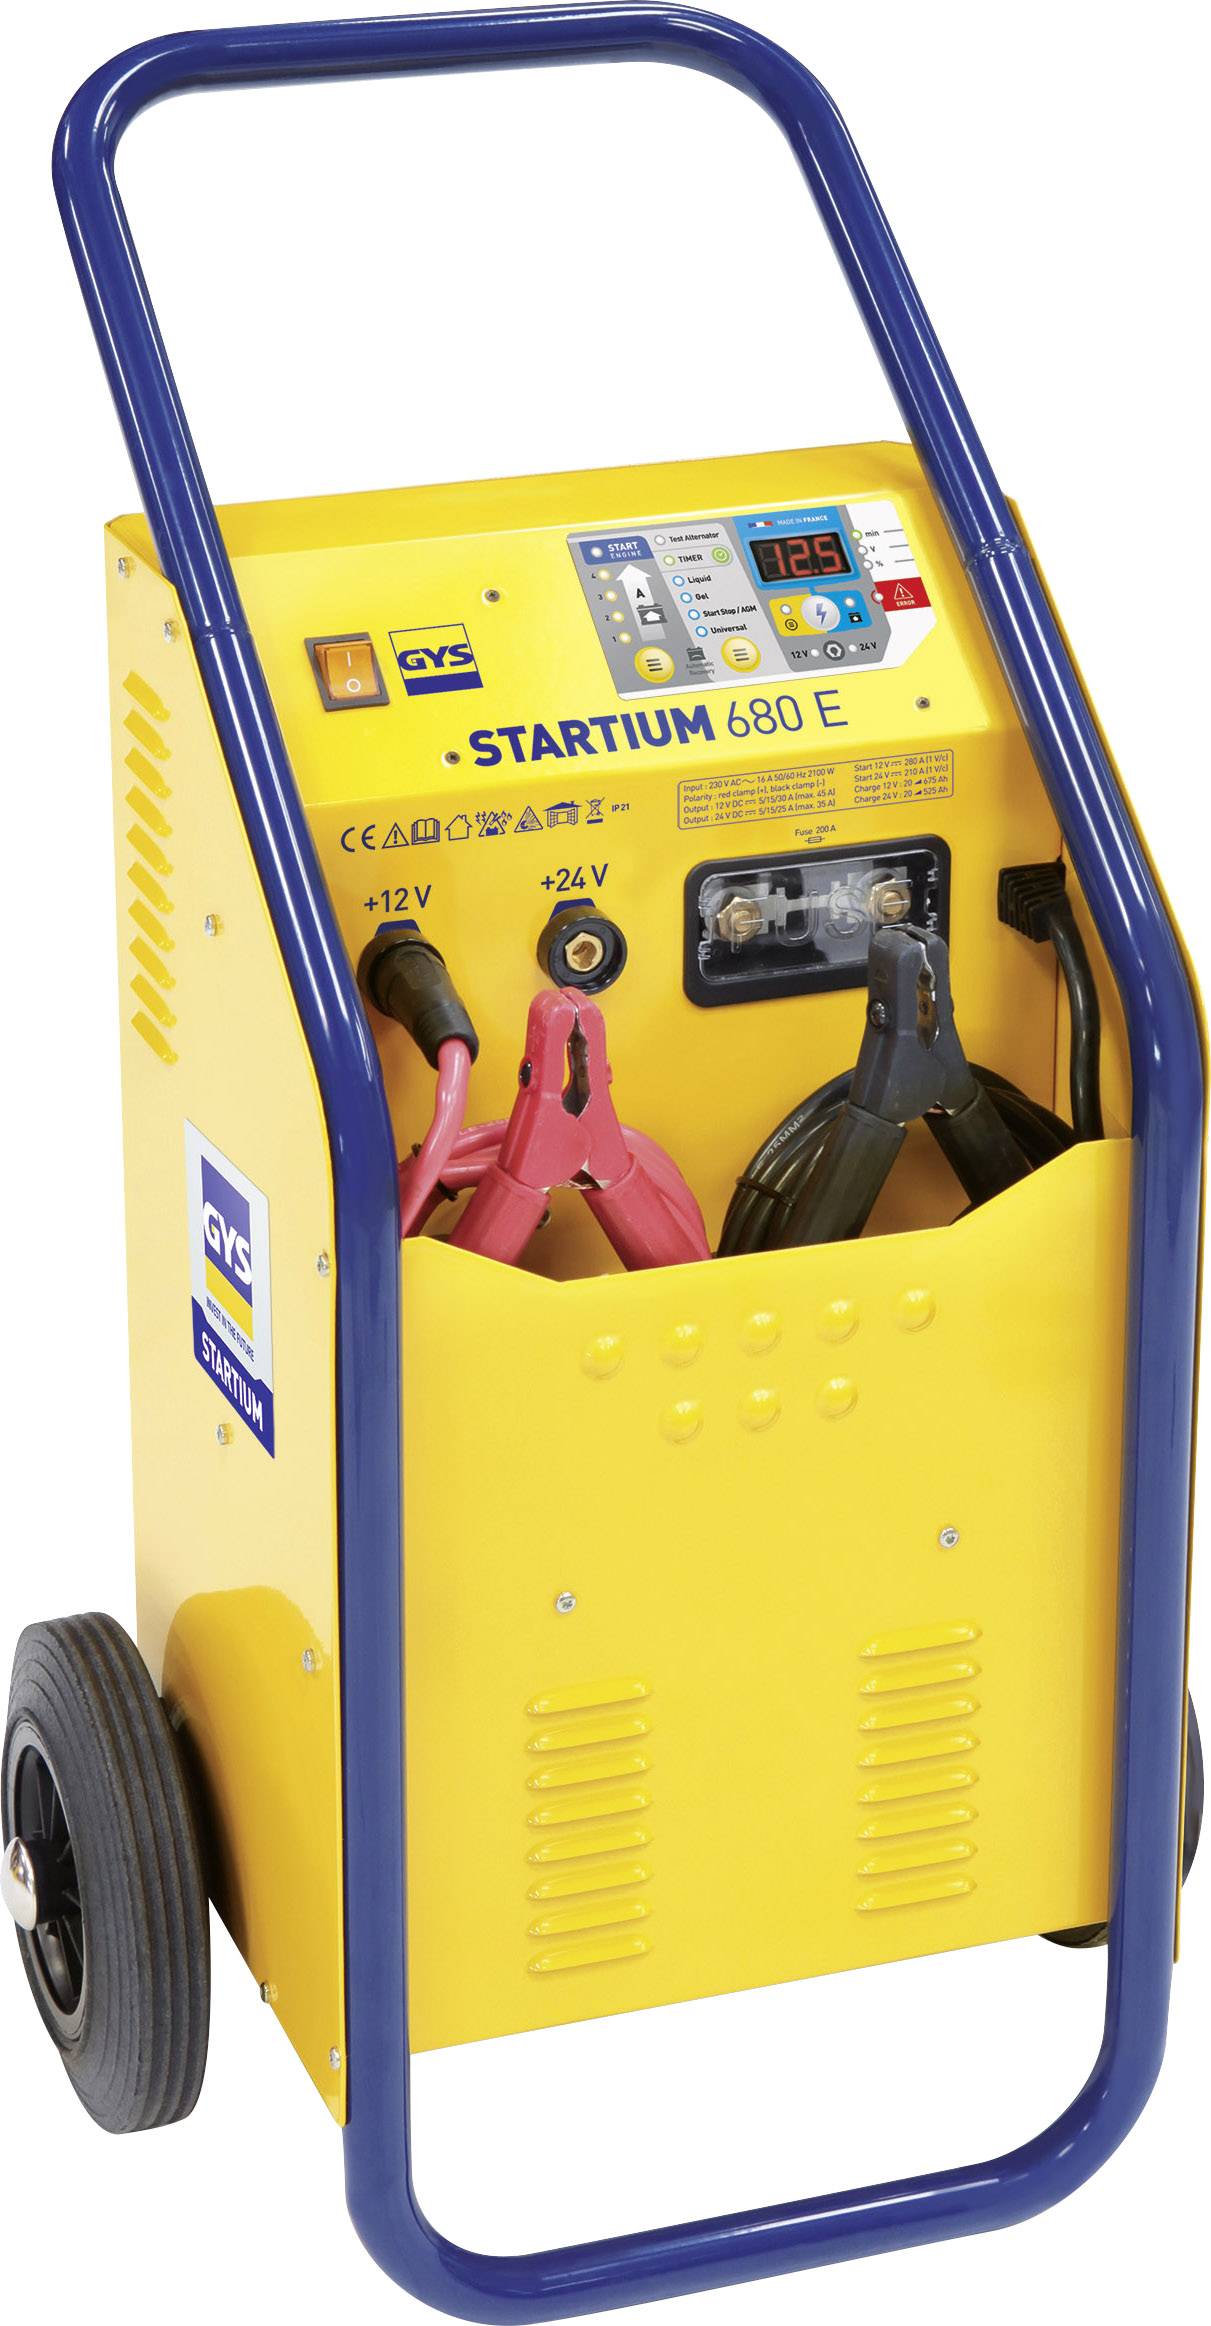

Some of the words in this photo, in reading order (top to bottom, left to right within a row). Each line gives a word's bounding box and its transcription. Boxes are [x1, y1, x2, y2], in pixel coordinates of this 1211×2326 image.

[777, 518, 794, 526] MADE
[803, 515, 828, 523] FRANCE
[669, 535, 684, 543] Test
[685, 531, 719, 541] Alternator
[608, 541, 638, 551] START
[610, 550, 642, 559] ENGINE
[678, 554, 703, 563] TIMER
[687, 575, 712, 585] Liquid
[636, 588, 645, 598] A
[703, 609, 720, 617] Start
[721, 608, 736, 616] Stop
[741, 605, 757, 613] AGM
[710, 623, 747, 634] Universal
[859, 643, 870, 651] 24
[397, 643, 474, 671] GYS
[468, 704, 715, 767] STARTIUM
[726, 694, 803, 738] 680
[814, 689, 848, 728] E
[854, 763, 872, 772] Start
[875, 761, 884, 769] 12
[904, 757, 918, 766] 280
[919, 756, 925, 764] A
[683, 784, 703, 793] Input
[708, 781, 723, 789] 230
[774, 772, 795, 782] 50/60
[808, 769, 826, 777] 2100
[826, 767, 835, 775] W
[854, 774, 872, 783] Start
[873, 772, 883, 780] 24
[884, 771, 890, 779] V
[904, 768, 918, 777] 210
[919, 767, 925, 775] A
[683, 793, 713, 803] Polarity
[718, 790, 731, 799] red
[732, 787, 756, 798] clamp
[770, 783, 790, 792] black
[791, 781, 815, 791] clamp
[854, 784, 881, 793] Charge
[883, 781, 892, 789] 12
[903, 779, 913, 787] 20
[923, 776, 937, 785] 675
[937, 775, 949, 783] Ah
[683, 804, 709, 814] Output
[715, 802, 724, 810] 12
[732, 800, 744, 808] DC
[758, 794, 787, 805] 5/15/30
[794, 791, 815, 801] (max.
[816, 789, 826, 797] 45
[854, 794, 881, 804] Charge
[882, 792, 892, 800] 24
[892, 791, 898, 799] V
[903, 790, 913, 798] 20
[923, 786, 937, 795] 525
[937, 785, 949, 793] Ah
[611, 804, 620, 813] IP
[621, 802, 630, 811] 21
[683, 814, 709, 825] Output
[715, 812, 724, 821] 24
[725, 811, 731, 819] V
[732, 810, 744, 818] DC
[758, 805, 787, 816] 5/15/25
[794, 801, 815, 811] (max.
[816, 800, 826, 808] 35
[795, 828, 813, 836] Fuse
[815, 826, 830, 834] 200
[540, 866, 586, 892] +24
[591, 863, 609, 888] V
[364, 888, 408, 913] +12
[414, 885, 432, 908] V
[203, 1201, 252, 1285] GYS
[206, 1296, 221, 1321] INVEST
[221, 1315, 227, 1329] IN
[227, 1321, 236, 1341] THE
[236, 1332, 255, 1363] FUTURE
[201, 1331, 264, 1432] STARTIUM
